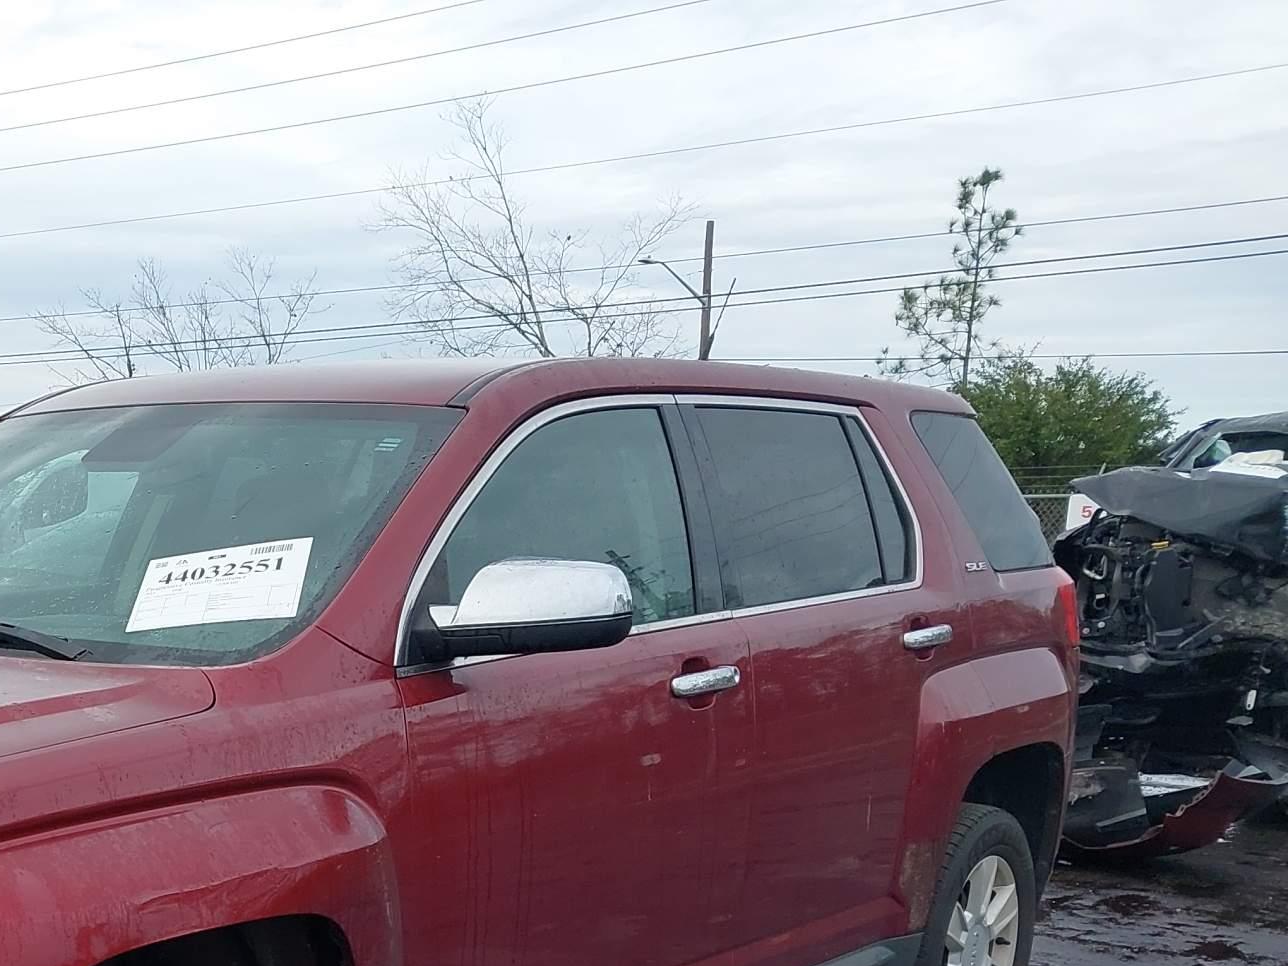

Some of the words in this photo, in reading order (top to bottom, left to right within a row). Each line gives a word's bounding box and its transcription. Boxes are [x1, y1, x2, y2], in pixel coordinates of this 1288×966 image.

[1081, 505, 1092, 519] 5
[158, 556, 285, 585] 44032551
[965, 561, 988, 571] SLE
